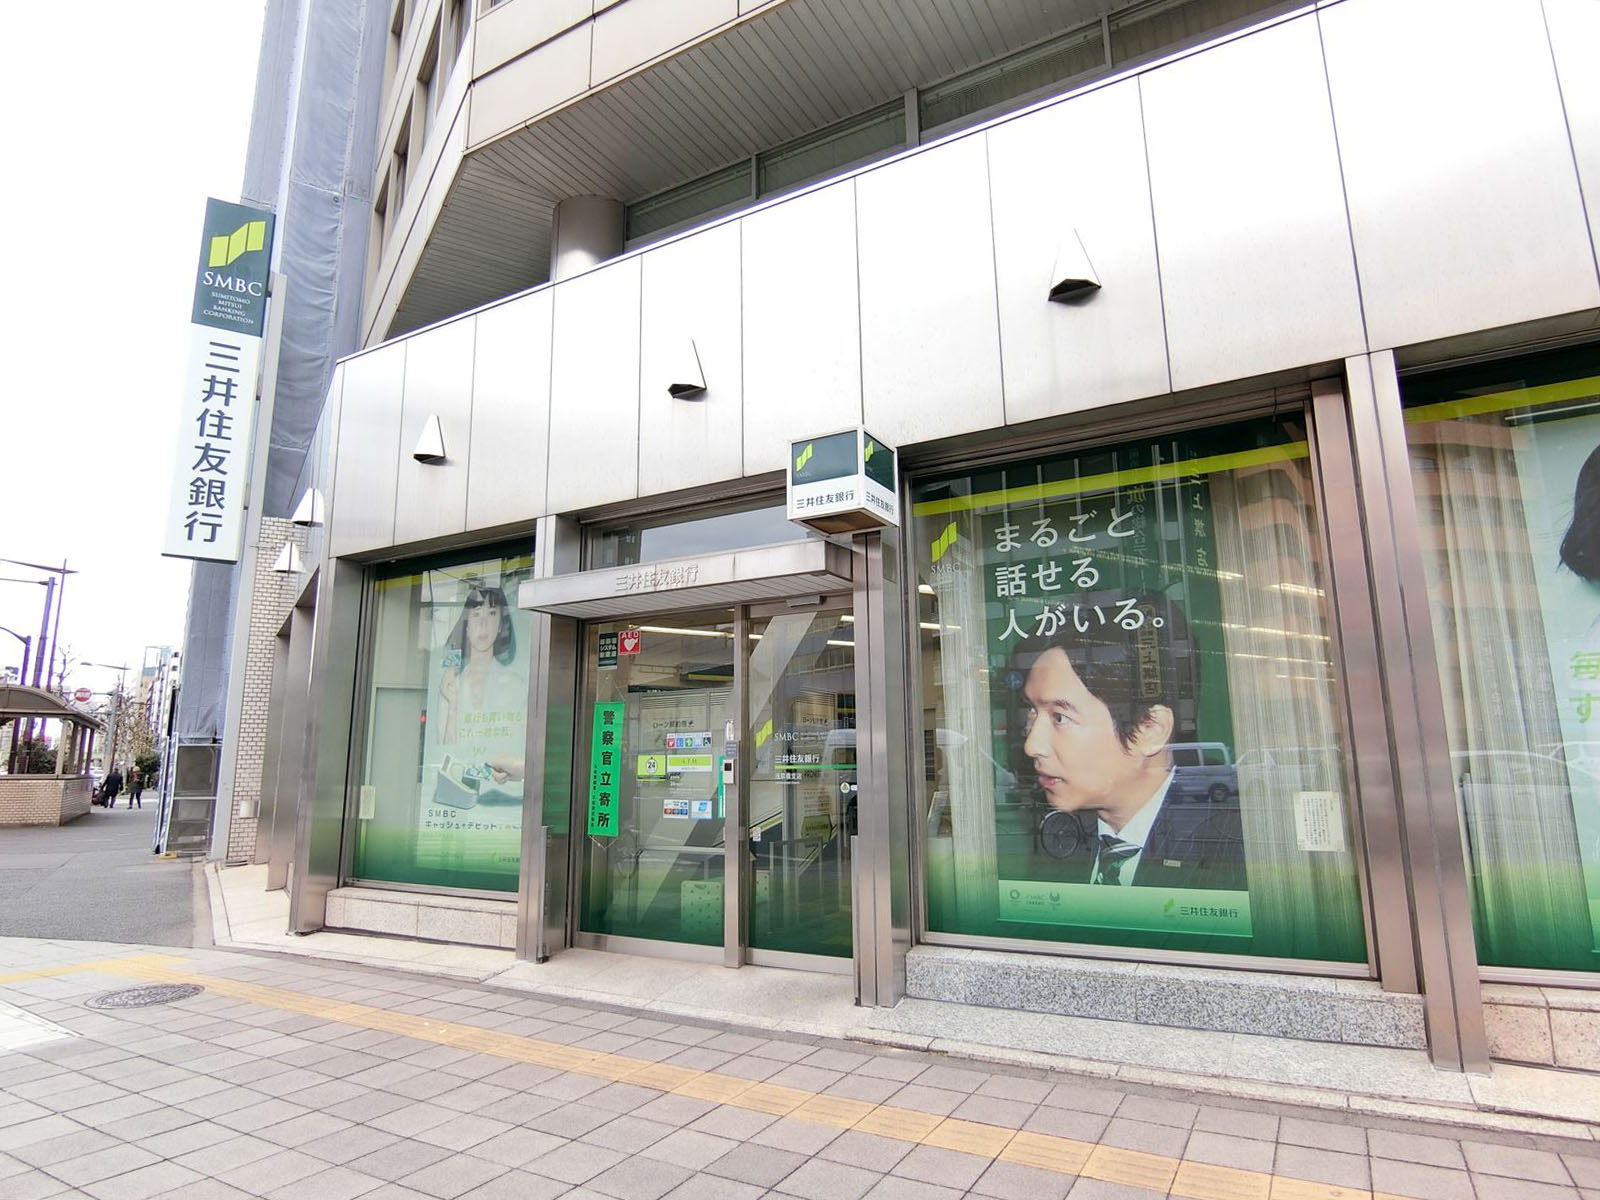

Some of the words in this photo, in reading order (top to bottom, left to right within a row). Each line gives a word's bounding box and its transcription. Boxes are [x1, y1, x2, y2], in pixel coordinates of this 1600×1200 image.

[203, 271, 262, 296] SMBC
[211, 292, 250, 304] SUMITOMO
[218, 300, 242, 309] MITSUI
[203, 309, 254, 324] CORPORATION
[213, 305, 246, 317] BANKING
[184, 341, 241, 543] 三井住友銀行
[797, 490, 855, 509] 三井住友銀行
[866, 491, 894, 515] 三井住友銀行
[994, 507, 1136, 553] まるごと
[930, 562, 960, 575] SMBC
[615, 565, 698, 591] 三井住友銀行
[995, 556, 1099, 598] 話せる
[998, 597, 1164, 641] 人がいる。
[774, 732, 799, 741] SMBC
[647, 761, 656, 769] 24
[775, 754, 820, 763] 三井住友銀行
[597, 710, 615, 828] 警察官立寄所
[428, 809, 457, 818] SMBC
[1180, 906, 1238, 918] 三井住友銀行
